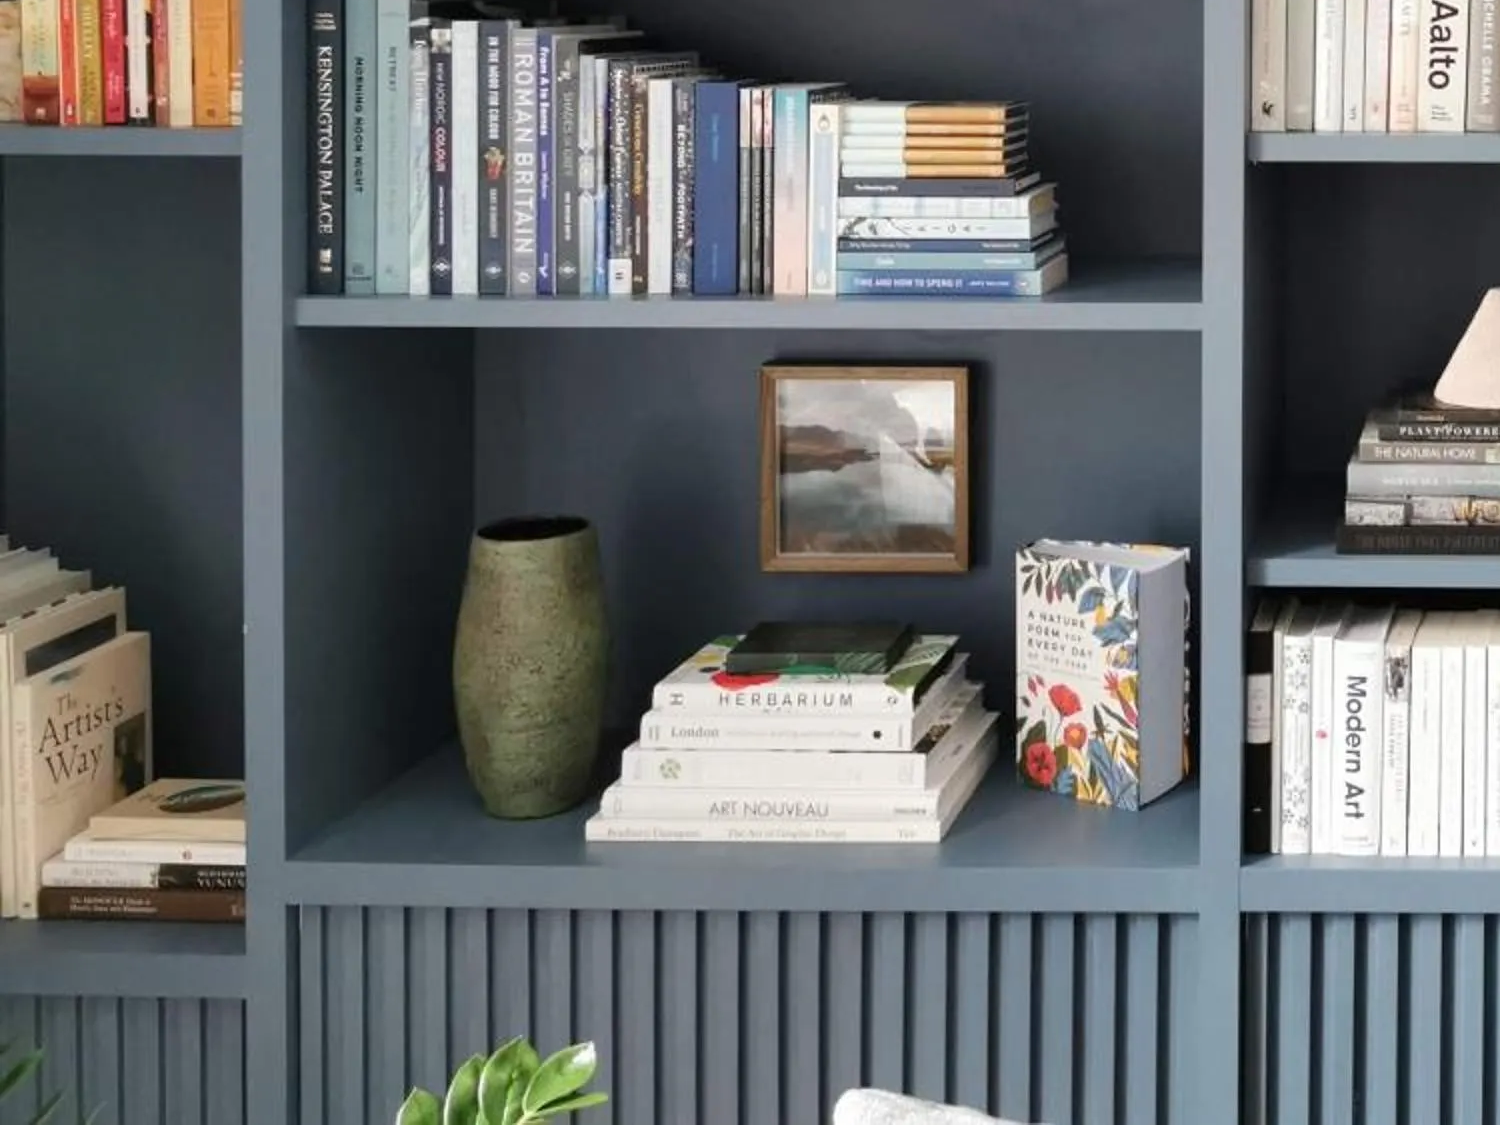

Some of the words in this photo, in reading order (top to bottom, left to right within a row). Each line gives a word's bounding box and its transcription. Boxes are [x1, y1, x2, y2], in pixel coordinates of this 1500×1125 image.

[1427, 0, 1460, 91] Aalto
[317, 45, 333, 165] KENSINGTON
[513, 52, 535, 143] ROMAN
[1480, 56, 1494, 106] OBAMA
[318, 169, 333, 235] PALACE
[513, 151, 534, 254] BRITAIN
[1026, 623, 1060, 638] POEM
[1027, 610, 1035, 620] A
[1039, 612, 1087, 629] NATURE
[39, 686, 124, 754] Artist's
[719, 693, 855, 708] HERBARIUM
[1345, 675, 1368, 774] Modern
[671, 726, 721, 739] London
[45, 744, 104, 784] Way
[710, 801, 738, 818] ART
[744, 801, 831, 819] NOUVEAU
[1343, 781, 1365, 820] Art
